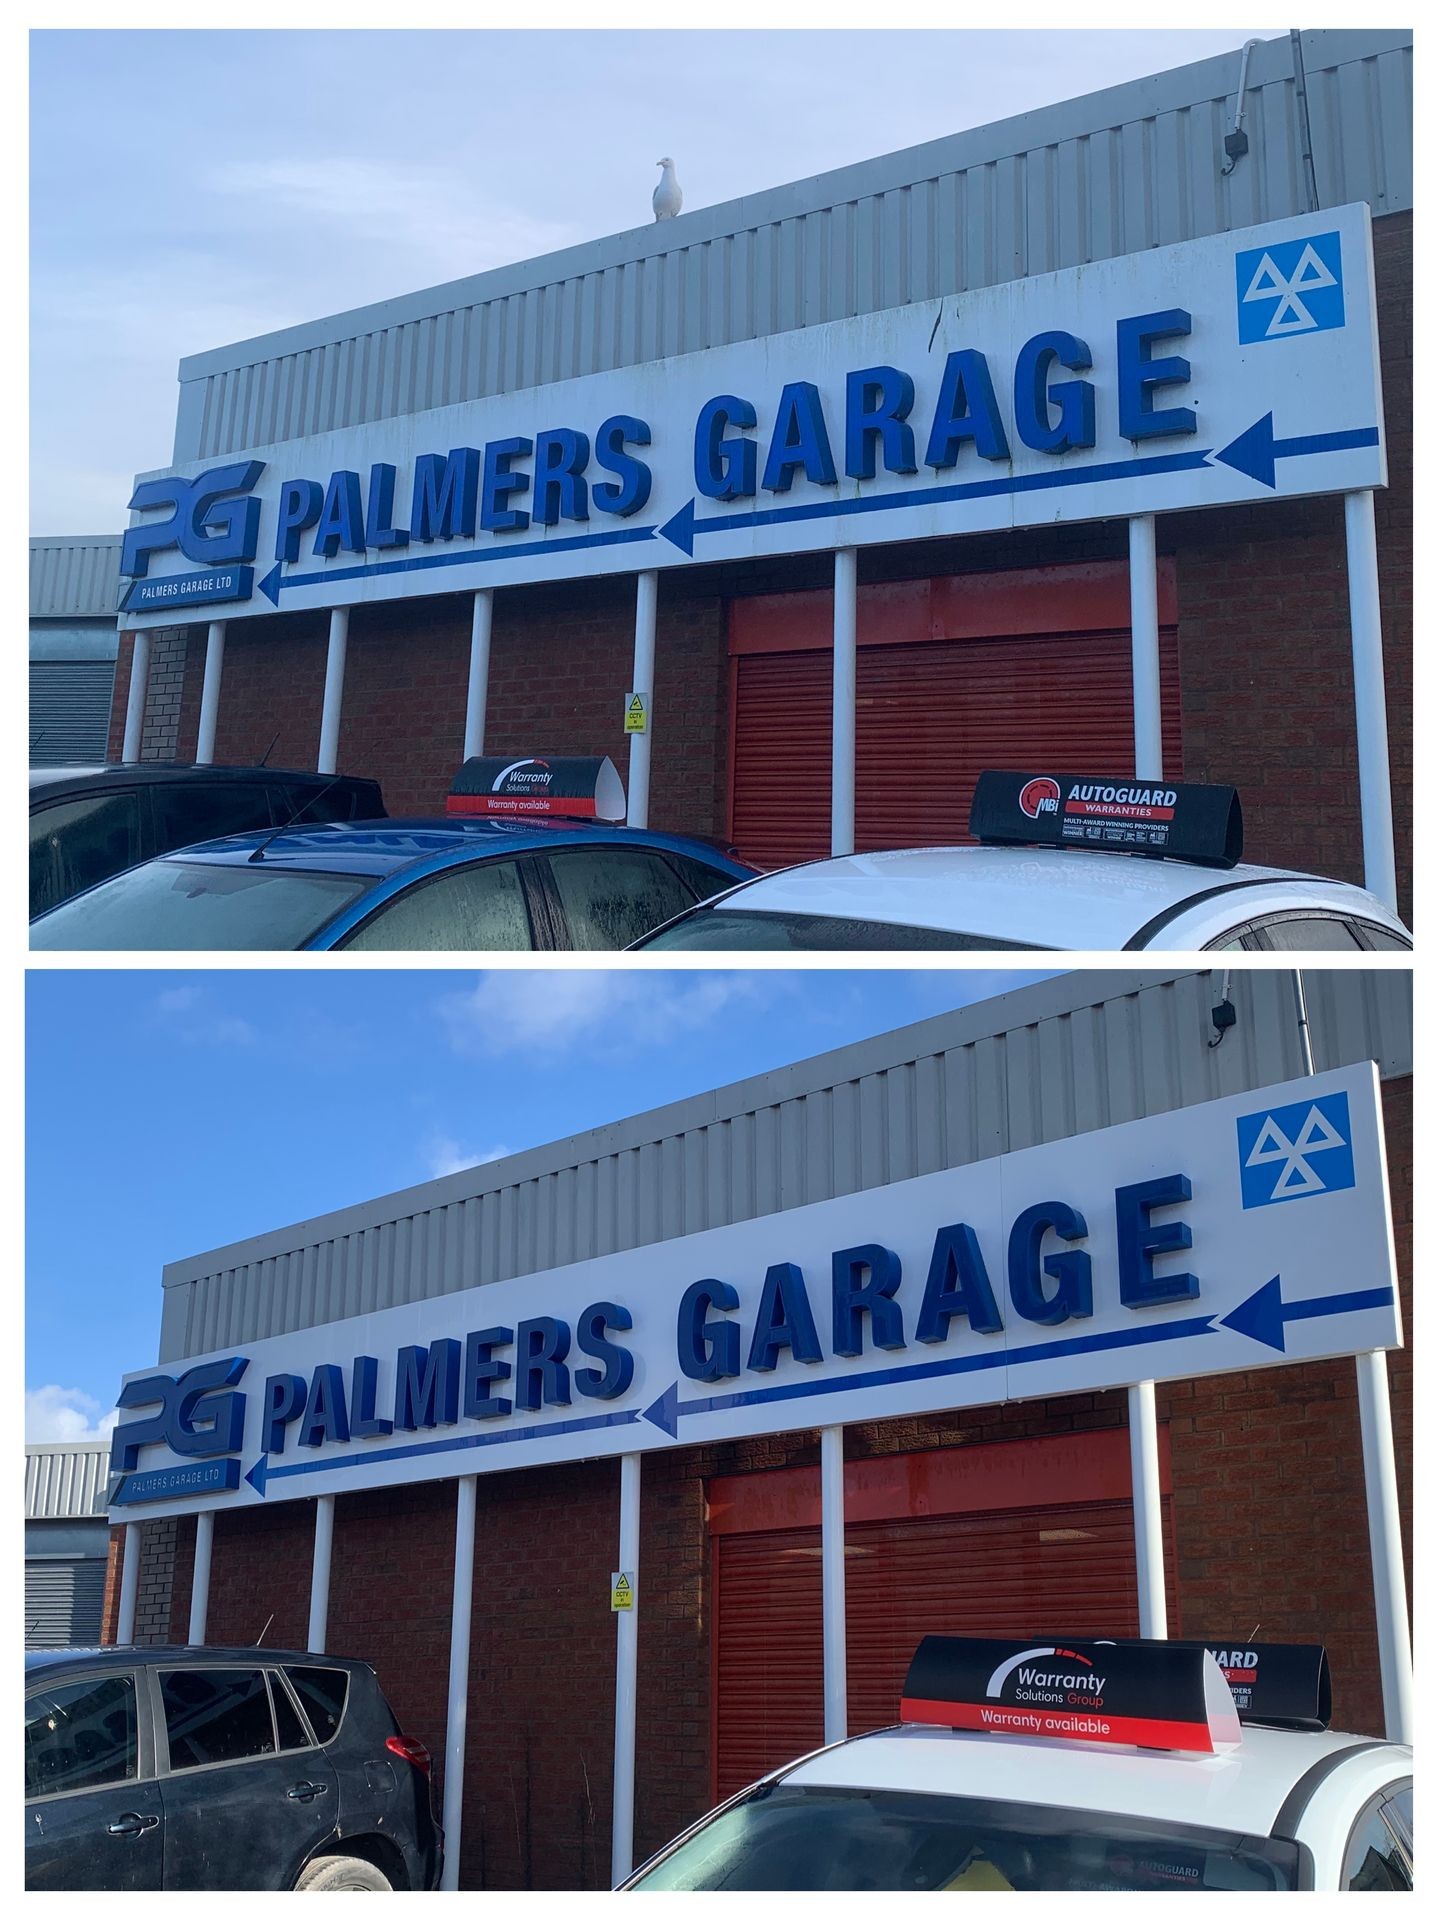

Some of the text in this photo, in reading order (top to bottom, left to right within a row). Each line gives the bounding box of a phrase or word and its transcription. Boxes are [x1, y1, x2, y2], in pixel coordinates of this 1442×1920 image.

[274, 307, 1198, 563] PALMERS GARAGE
[120, 460, 266, 578] PG
[141, 576, 232, 599] PALMERS GARAGE LTD
[505, 783, 530, 792] Solutions
[509, 771, 554, 786] Warranty
[487, 799, 551, 812] Warranty available
[1068, 784, 1178, 807] AUTOGUARD
[1085, 804, 1153, 817] WARRANTIES
[1063, 817, 1169, 832] MULTI-AWARD WINNING PROVIDERS
[261, 1173, 1201, 1455] PALMERS GARAGE
[110, 1356, 250, 1473] PG
[132, 1468, 219, 1492] PALMERS GARAGE LTD
[1018, 1668, 1106, 1696] Warranty
[1015, 1688, 1104, 1709] Solutions Group
[980, 1709, 1111, 1735] Warranty available
